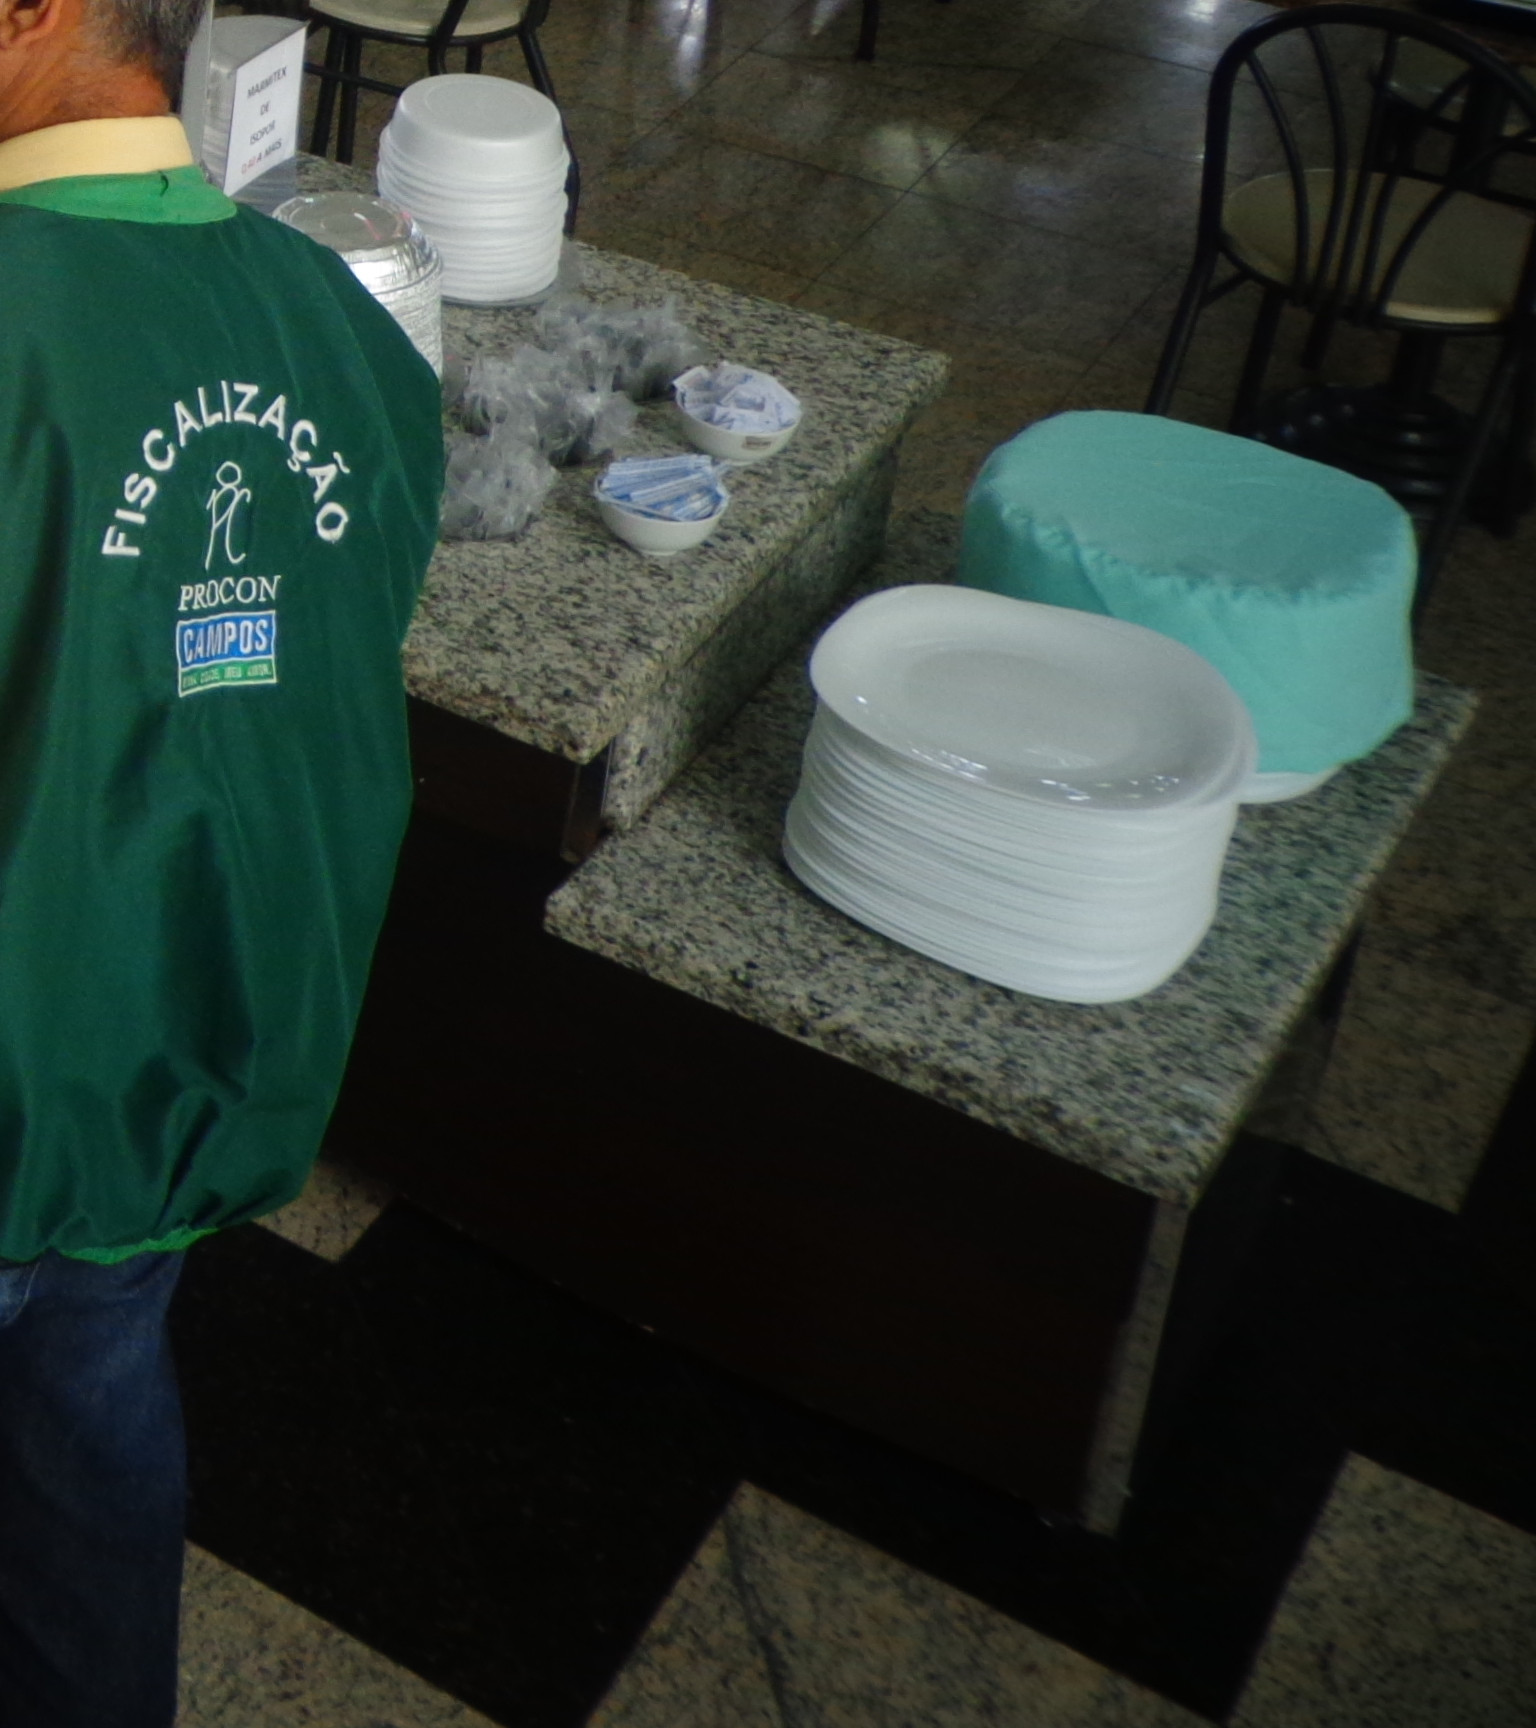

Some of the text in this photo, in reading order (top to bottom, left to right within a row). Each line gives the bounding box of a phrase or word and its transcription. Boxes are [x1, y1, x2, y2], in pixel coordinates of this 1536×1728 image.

[247, 65, 288, 100] MARMITEX
[260, 100, 270, 116] DE
[249, 120, 276, 146] ISOPOR
[101, 379, 351, 558] FISCALIZAÇÃO
[177, 574, 282, 612] PROCON
[182, 618, 269, 664] CAMPOS
